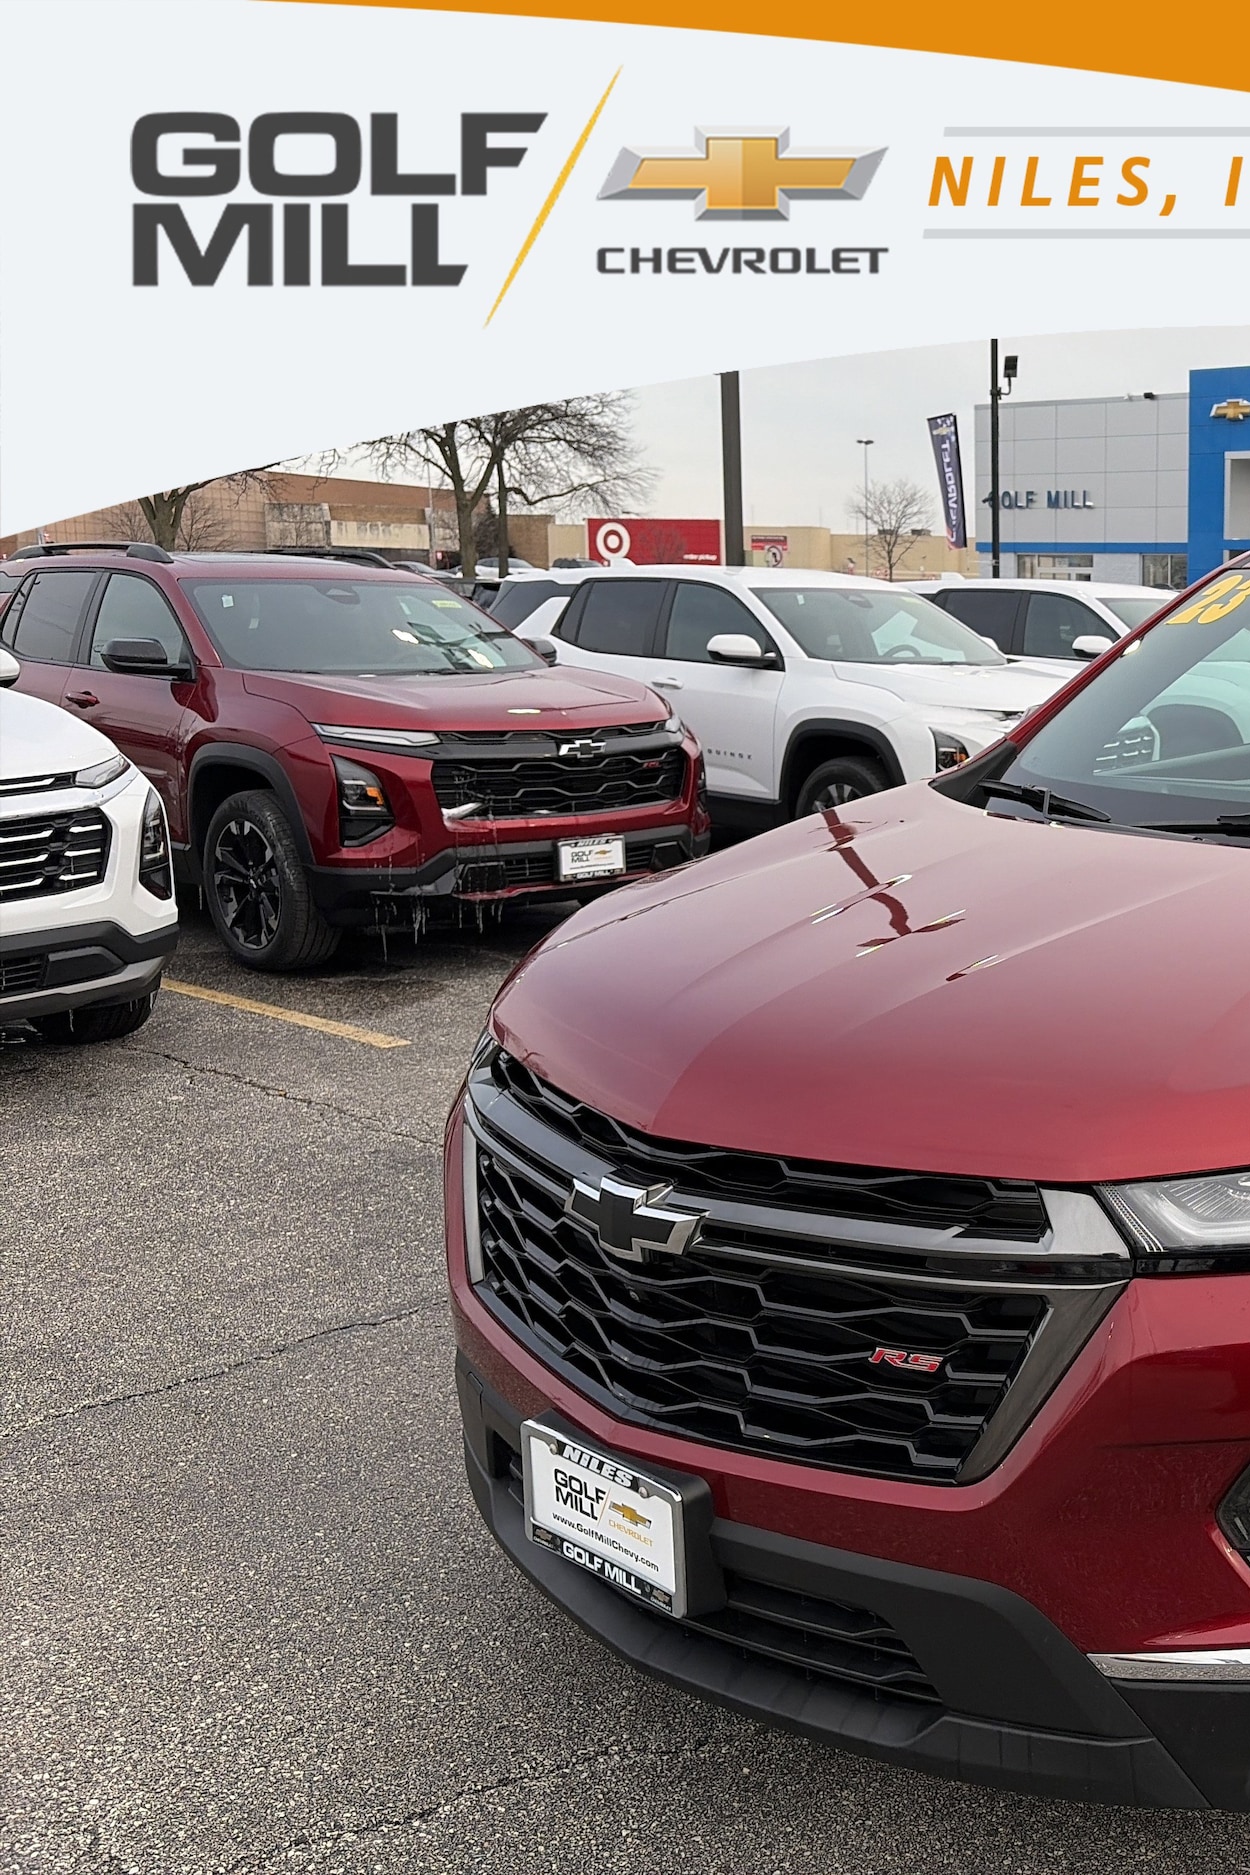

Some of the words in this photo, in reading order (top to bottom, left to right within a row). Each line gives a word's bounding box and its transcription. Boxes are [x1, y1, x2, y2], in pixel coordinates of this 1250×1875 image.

[1047, 489, 1094, 509] MILL
[706, 747, 753, 760] QUINOX
[868, 1347, 944, 1373] RS
[562, 1444, 633, 1487] NILES
[554, 1468, 607, 1505] GOLF
[555, 1487, 599, 1521] MILL
[552, 1511, 660, 1573] www.GolfMillChevy.com
[608, 1519, 654, 1547] CHEVROLET
[561, 1540, 604, 1572] GOLF
[604, 1562, 642, 1595] MILL
